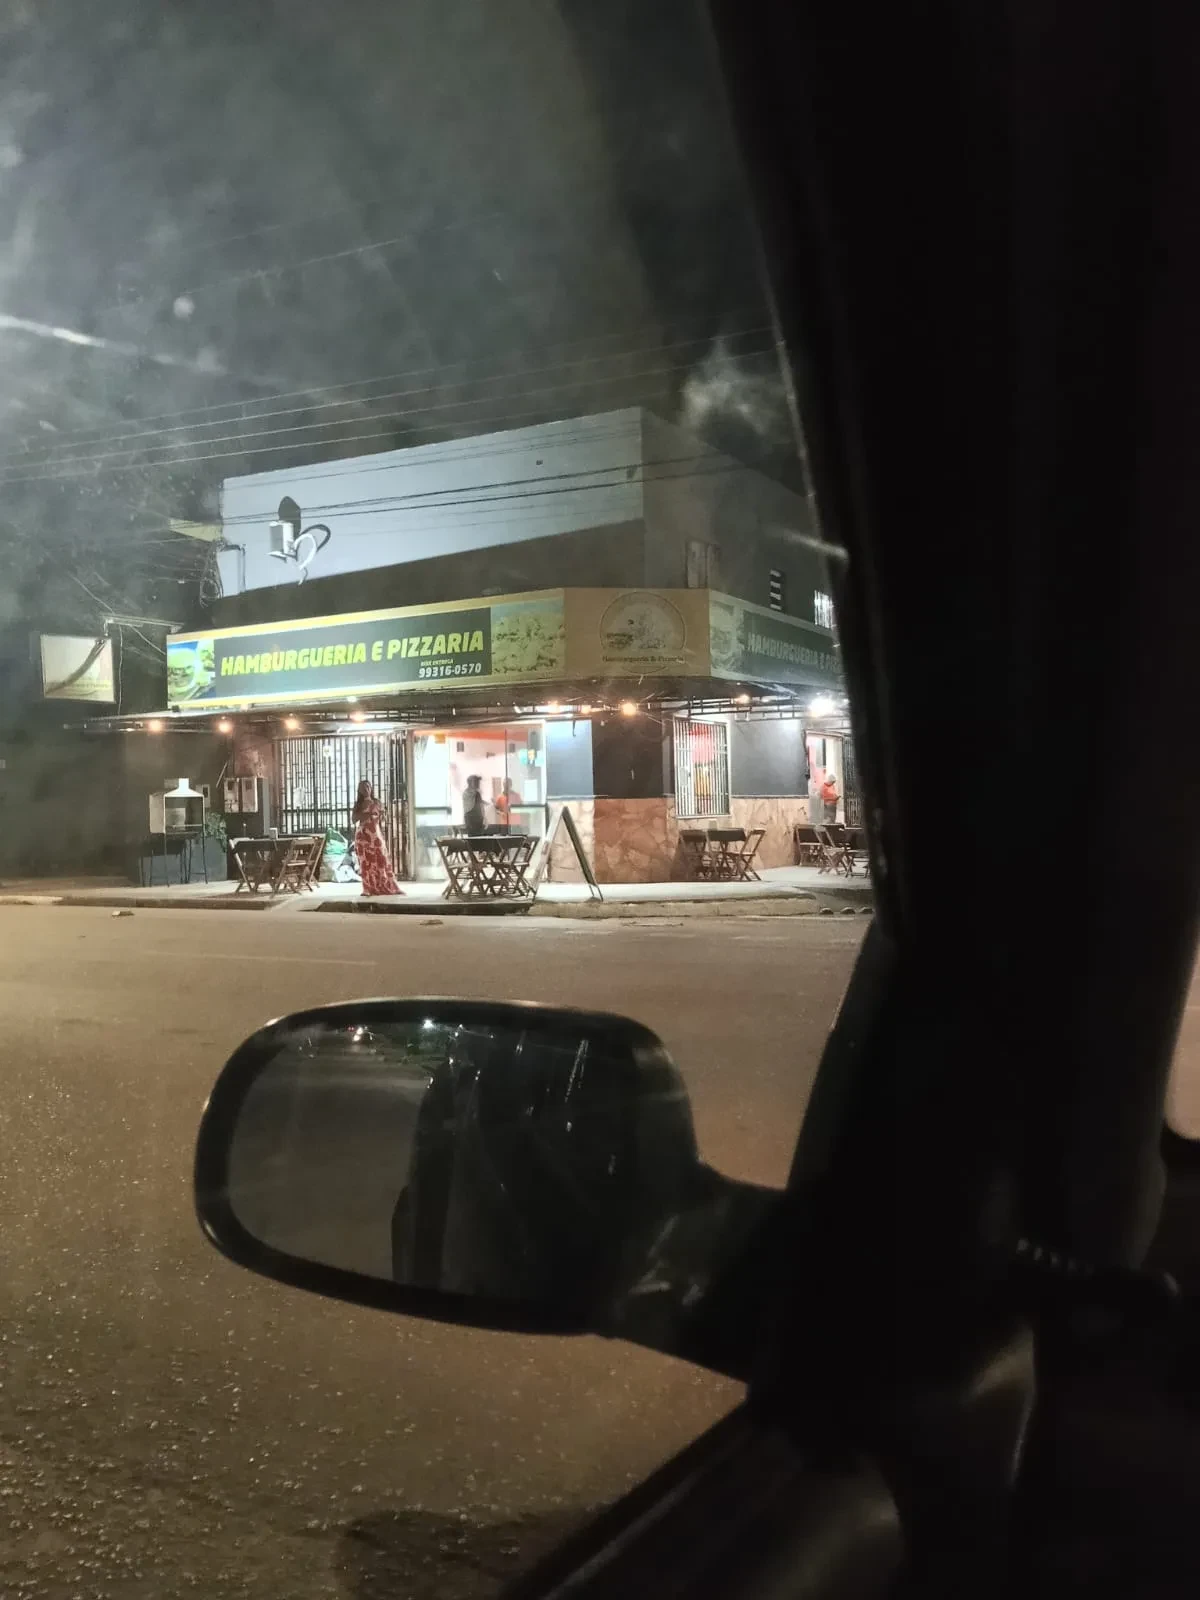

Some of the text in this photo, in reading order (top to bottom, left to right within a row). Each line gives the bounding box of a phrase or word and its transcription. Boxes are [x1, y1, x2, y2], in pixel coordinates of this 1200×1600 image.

[220, 630, 484, 677] HAMBURGUERIA E PIZZARIA
[418, 662, 482, 678] 99316-0570
